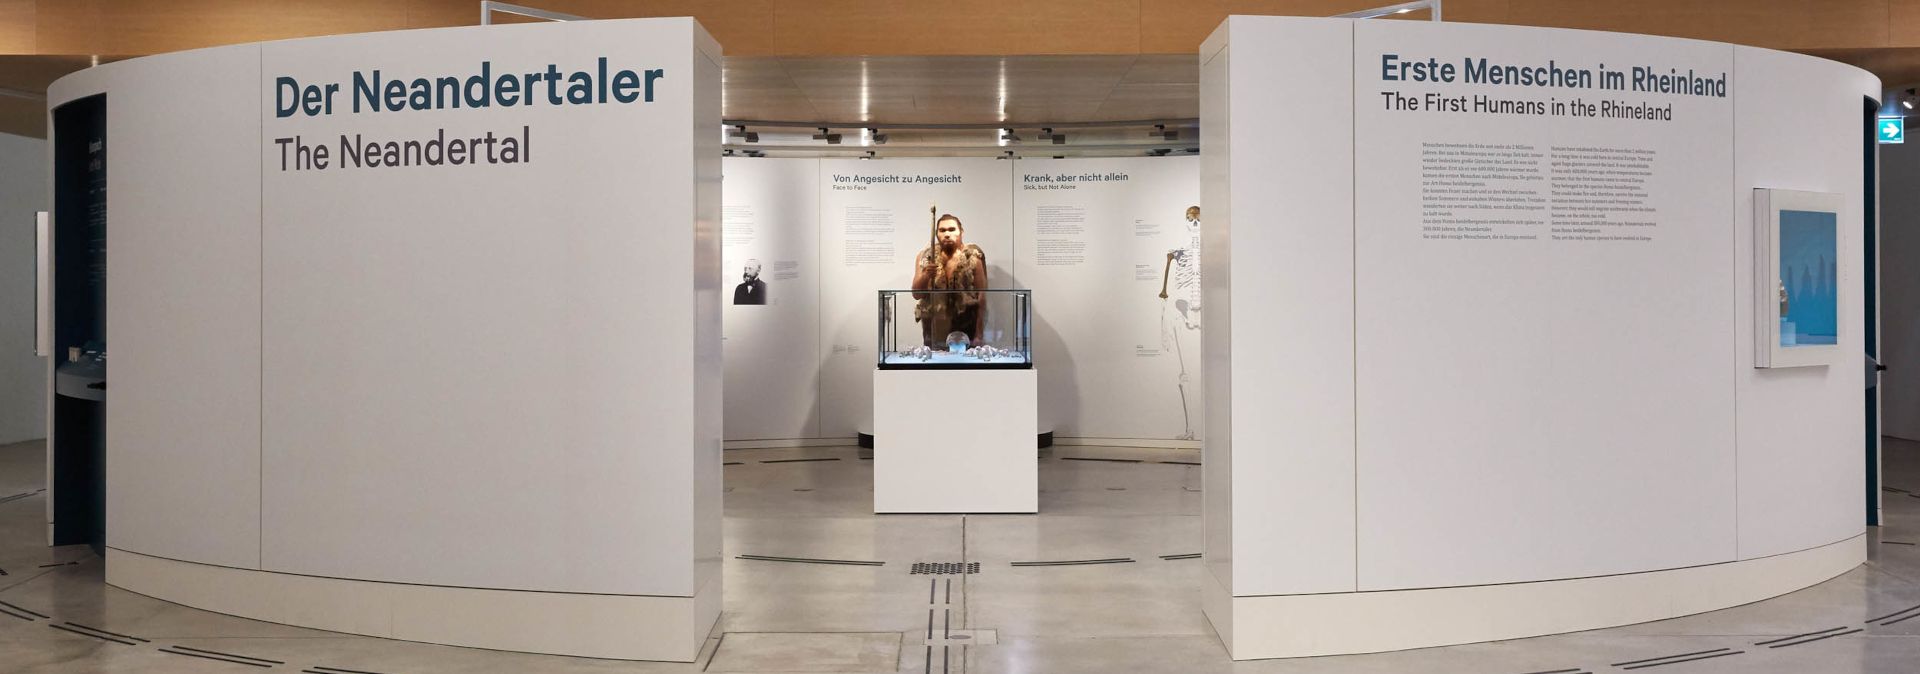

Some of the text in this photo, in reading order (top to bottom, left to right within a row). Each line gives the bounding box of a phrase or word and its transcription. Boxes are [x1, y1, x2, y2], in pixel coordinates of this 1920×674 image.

[276, 57, 664, 118] Der Neandertaler
[1381, 54, 1726, 97] Erste Menschen im Rheinland
[1381, 92, 1672, 121] The First Humans in the Rhineland
[275, 125, 530, 171] The Neandertal
[833, 174, 851, 183] Von
[853, 174, 899, 185] Angesicht
[915, 174, 962, 185] Angesicht
[1024, 172, 1129, 183] Krank, aber nicht allein
